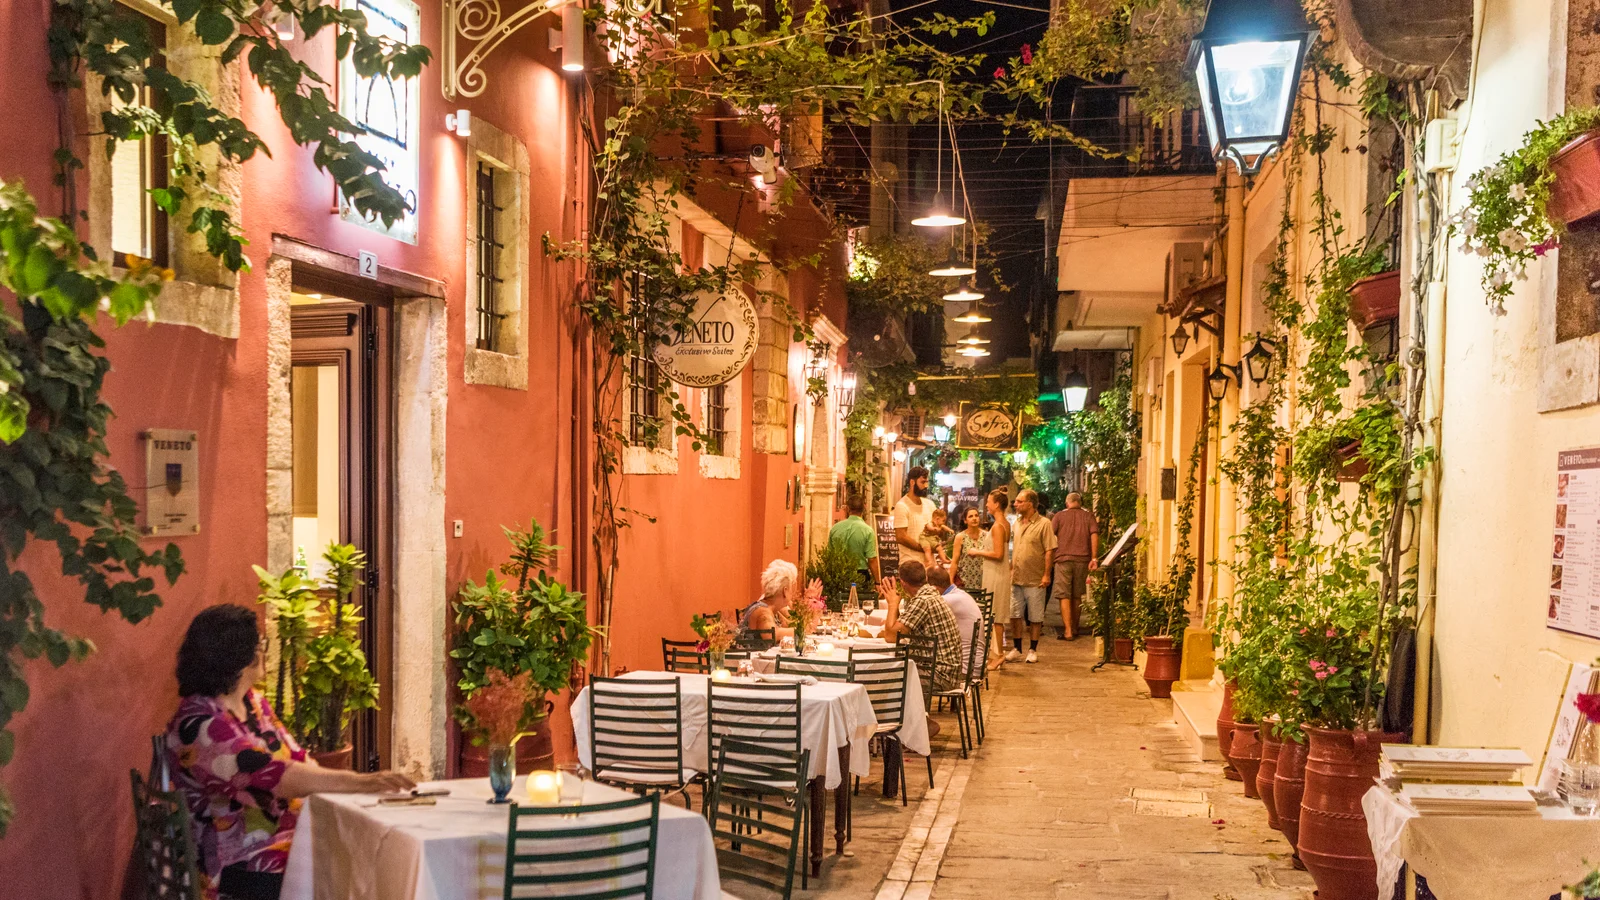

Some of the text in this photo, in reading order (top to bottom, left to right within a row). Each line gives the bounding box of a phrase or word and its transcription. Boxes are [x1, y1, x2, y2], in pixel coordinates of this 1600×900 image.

[365, 257, 372, 274] 2
[675, 346, 734, 355] Exclusive Suites
[154, 441, 192, 451] VENETO
